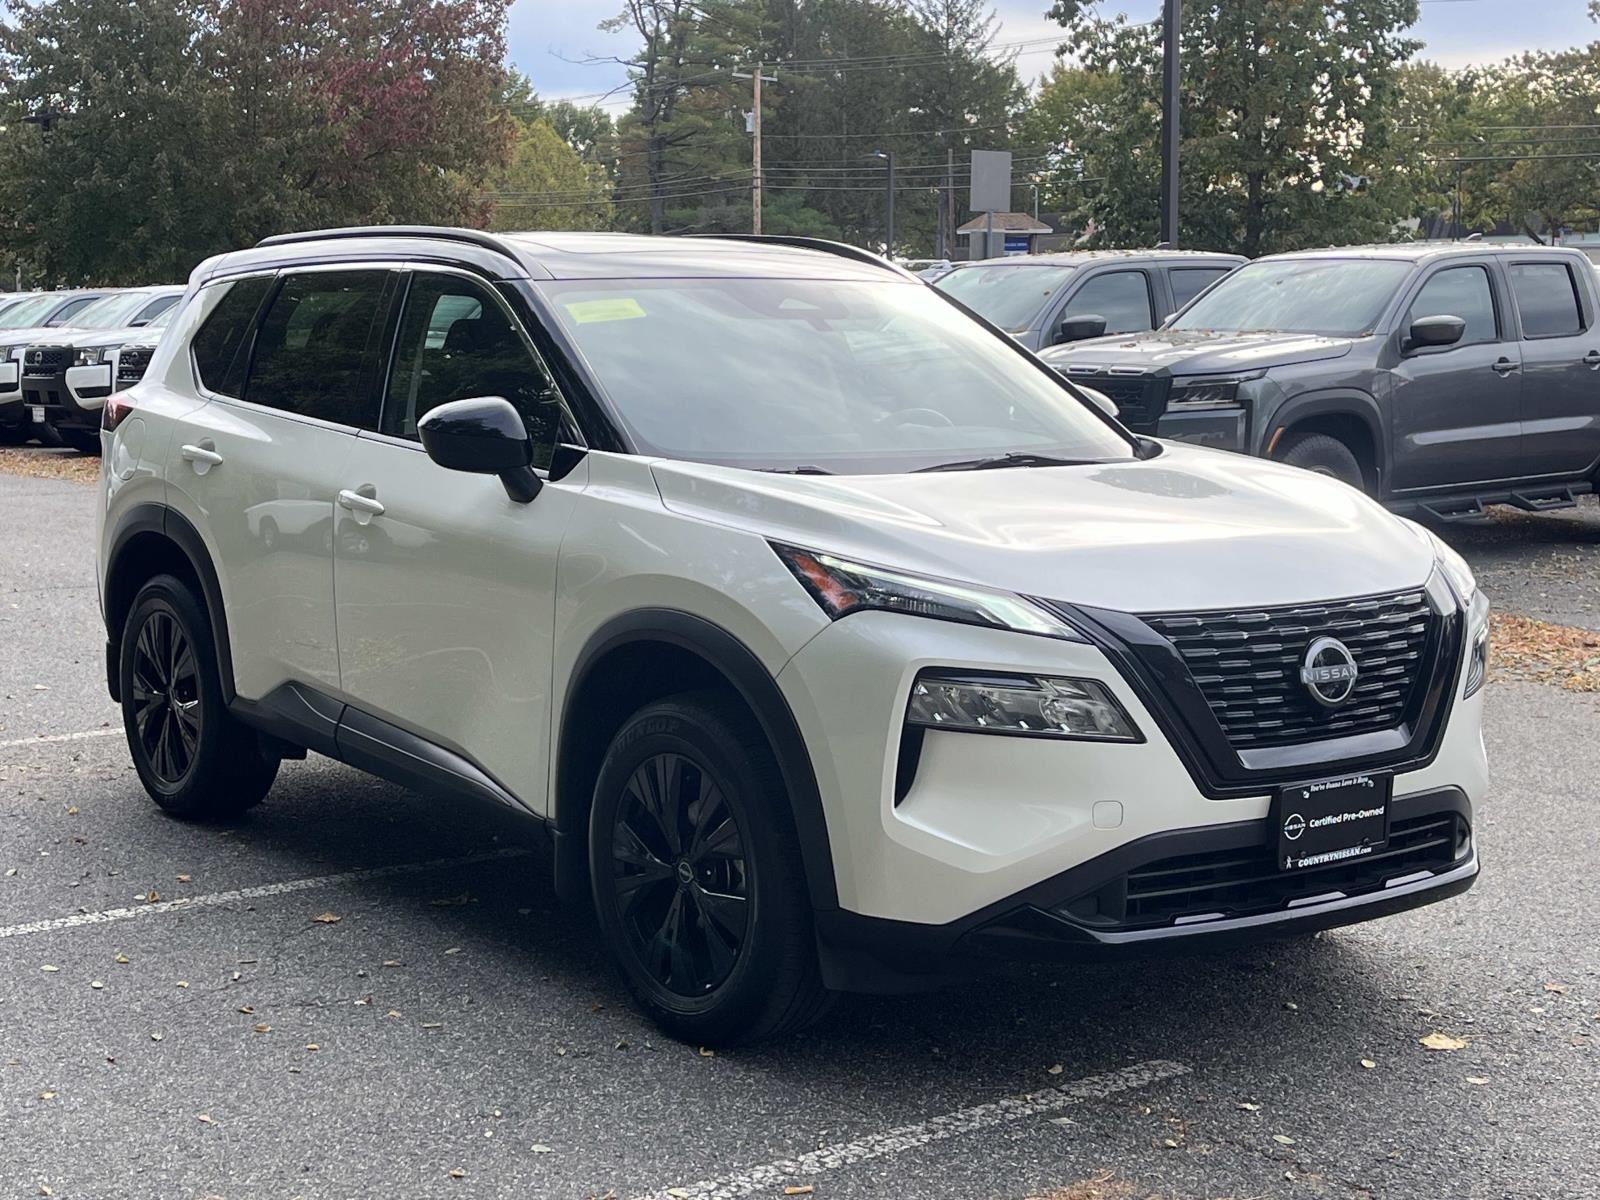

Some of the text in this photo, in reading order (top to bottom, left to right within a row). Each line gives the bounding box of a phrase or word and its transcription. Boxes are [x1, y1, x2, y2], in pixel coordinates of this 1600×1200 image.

[1303, 666, 1358, 684] NISSAN
[1309, 805, 1385, 828] Certified Pre-Owned
[1298, 847, 1372, 868] COUNTRYNISSAN.com
